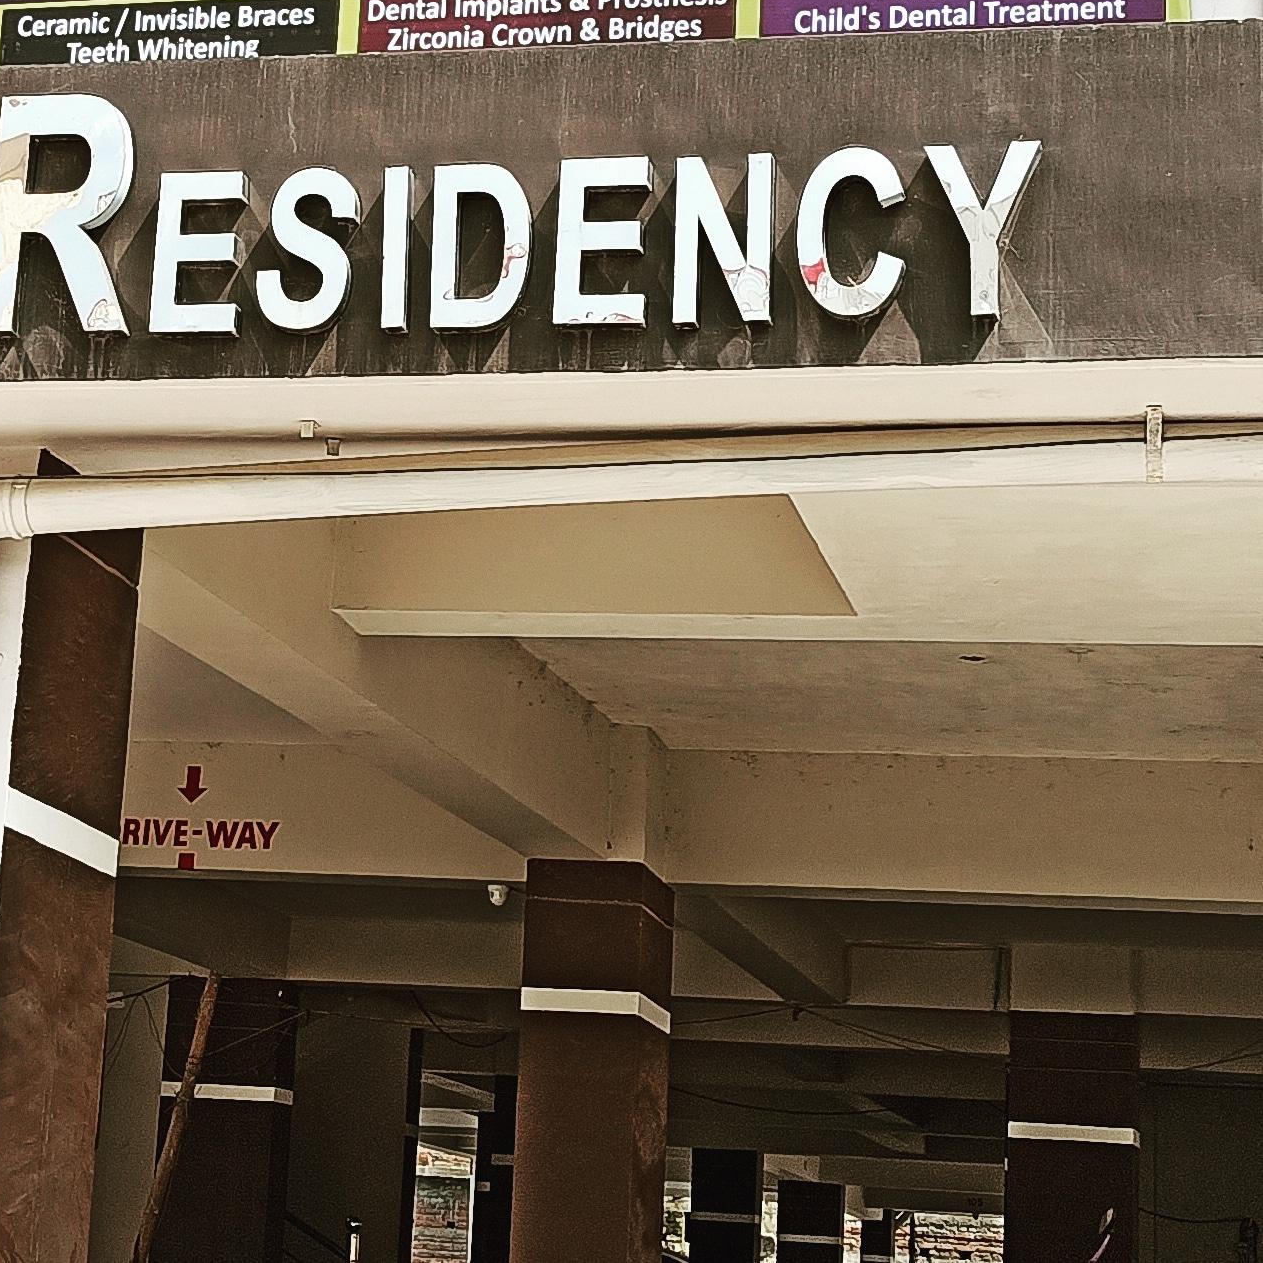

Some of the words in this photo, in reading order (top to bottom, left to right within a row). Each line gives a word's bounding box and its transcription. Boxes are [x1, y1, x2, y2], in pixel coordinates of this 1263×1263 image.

[18, 12, 110, 37] Ceramic
[134, 5, 231, 31] Invisible
[238, 6, 314, 27] Braces
[388, 25, 484, 51] Zirconia
[492, 23, 572, 47] Crown
[580, 18, 600, 41] &
[608, 16, 701, 44] Bridges
[794, 7, 880, 34] Child's
[888, 2, 976, 30] Dental
[67, 40, 129, 64] Teeth
[138, 35, 259, 61] Whitening
[122, 818, 280, 850] RIVE-WAY
